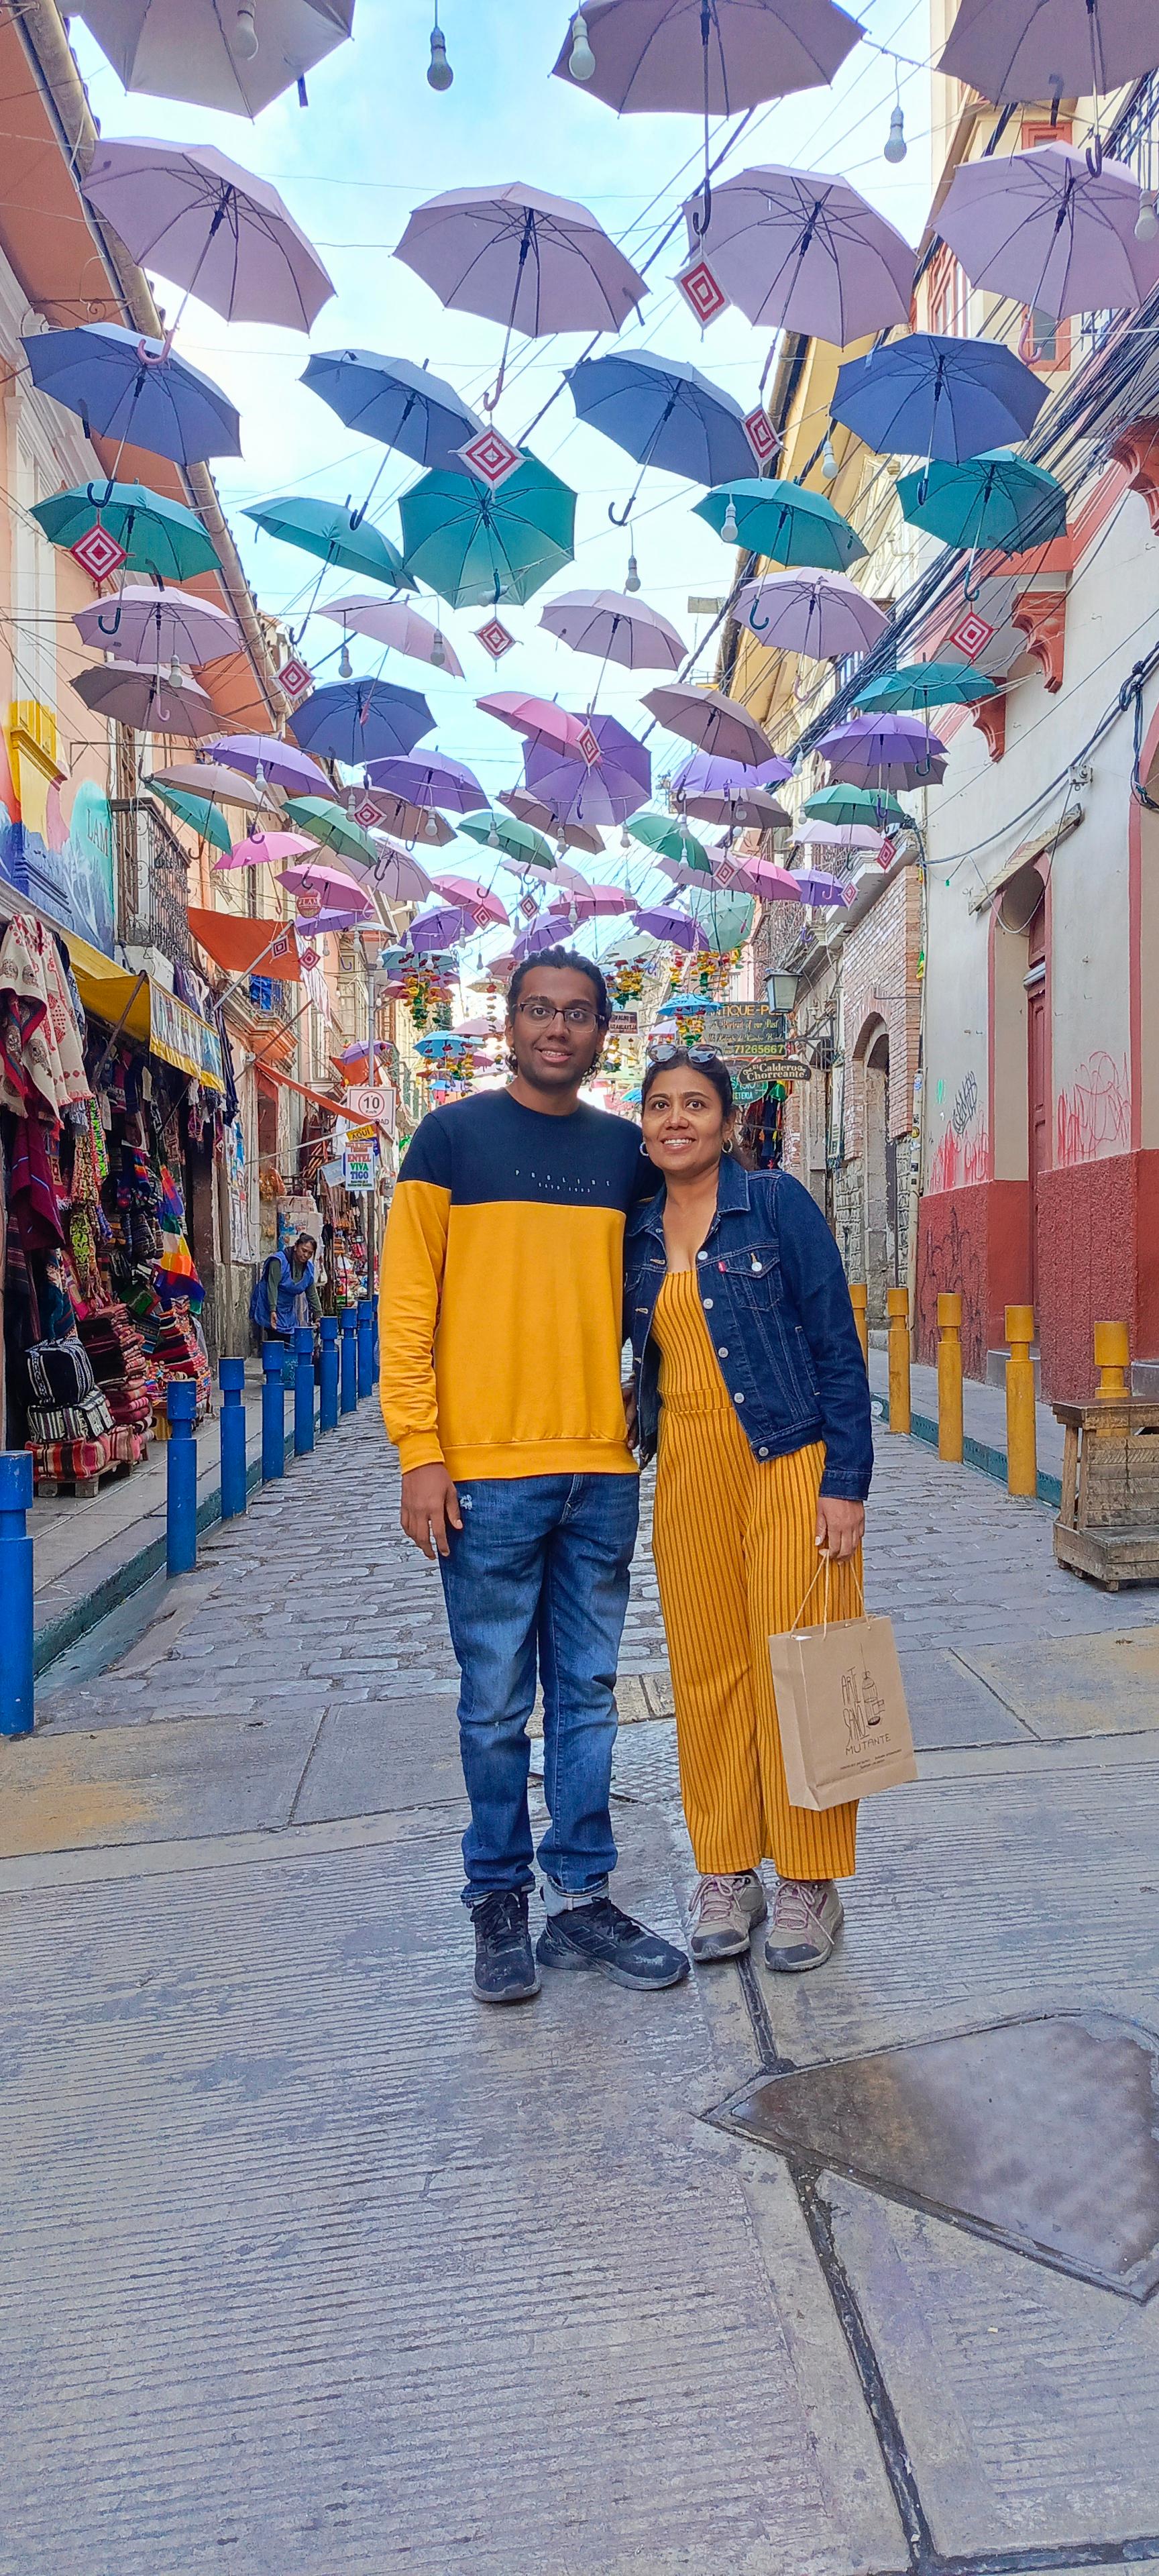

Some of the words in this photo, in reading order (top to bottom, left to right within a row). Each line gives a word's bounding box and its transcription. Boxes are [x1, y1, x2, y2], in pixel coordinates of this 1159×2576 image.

[734, 1044, 784, 1054] 71265667
[747, 1070, 805, 1081] Chorreante
[363, 1097, 380, 1109] 10
[347, 1154, 371, 1163] ENTEL
[350, 1163, 369, 1171] VIVA
[350, 1171, 369, 1179] TIGO
[845, 1733, 891, 1756] MUTANTE
